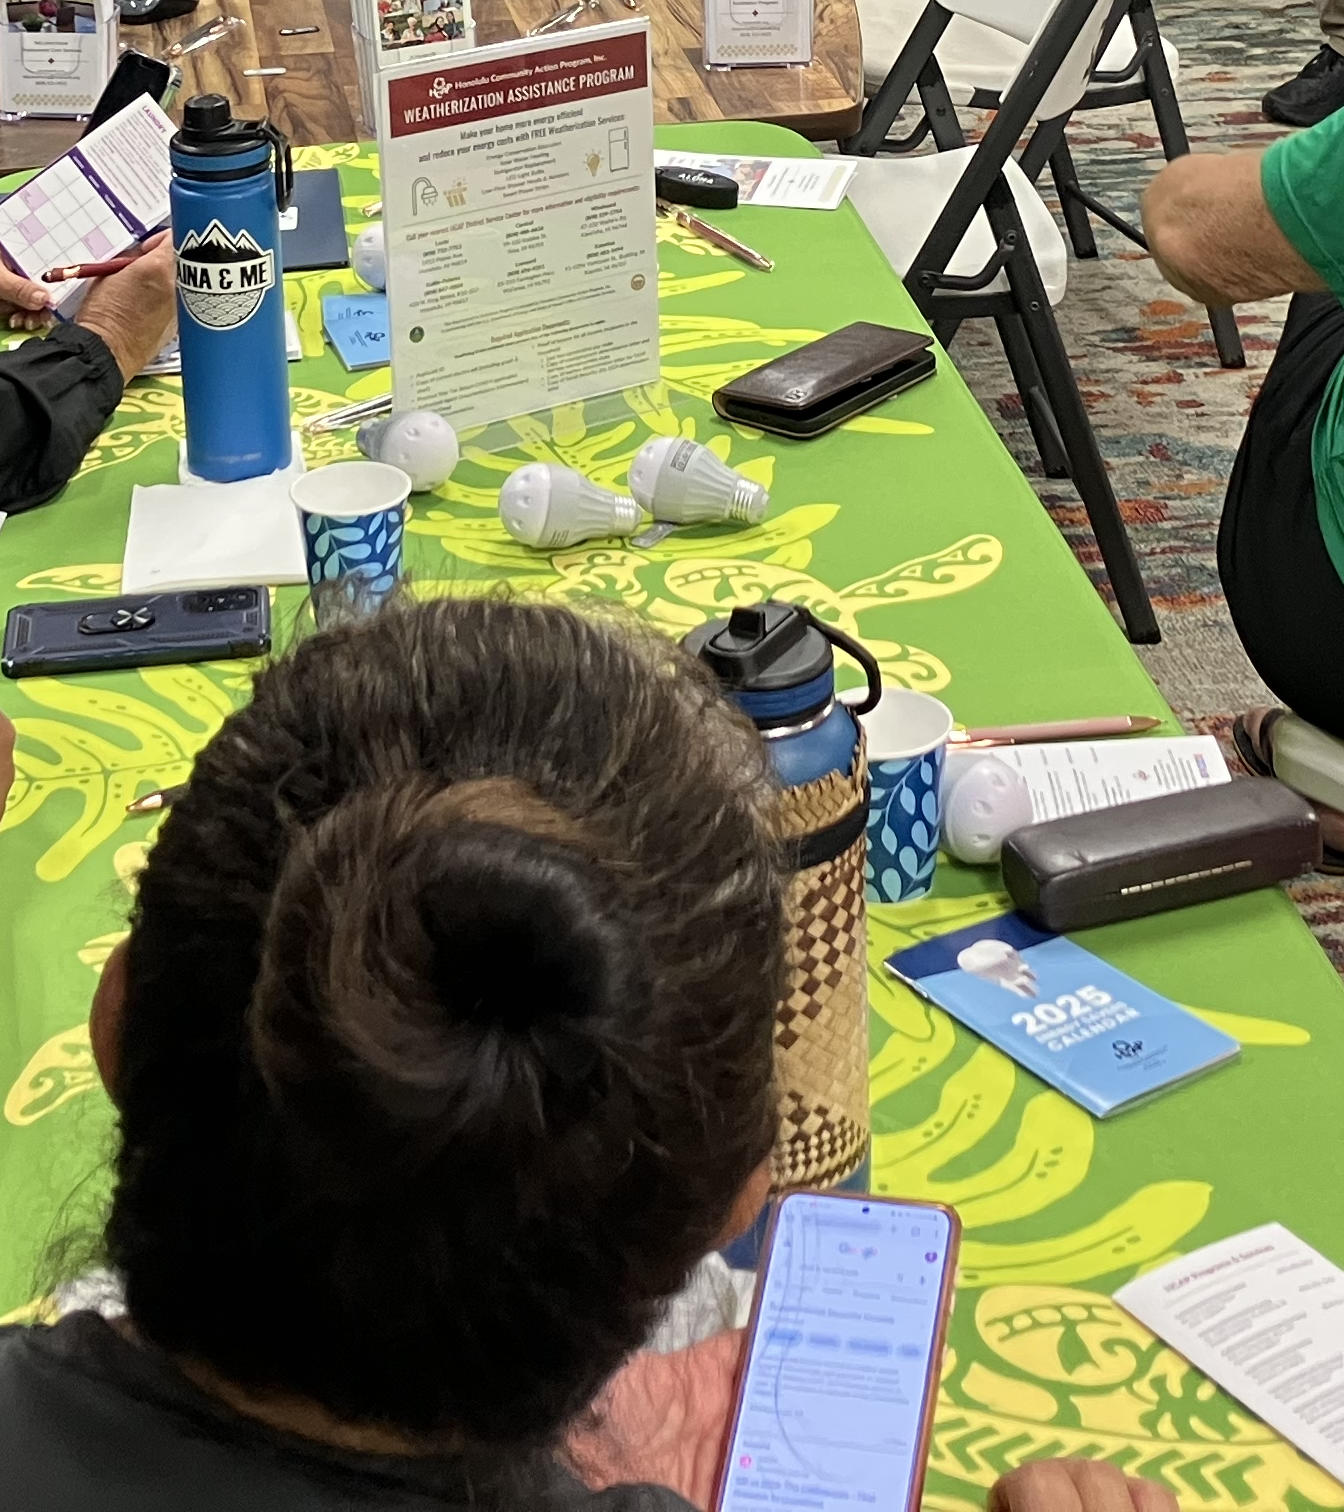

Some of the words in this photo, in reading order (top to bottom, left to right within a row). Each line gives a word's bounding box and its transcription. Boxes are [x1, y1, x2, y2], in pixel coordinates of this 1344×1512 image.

[403, 91, 505, 124] WEATHERIZATION
[507, 77, 576, 103] ASSISTANCE
[578, 65, 635, 90] PROGRAM
[455, 76, 490, 90] Honolulu
[491, 67, 534, 84] Community
[534, 62, 559, 74] Action
[593, 54, 607, 63] Inc.
[219, 268, 233, 290] &
[240, 260, 268, 288] ME
[1011, 985, 1112, 1036] 2025
[1047, 1007, 1141, 1052] CALENDAR
